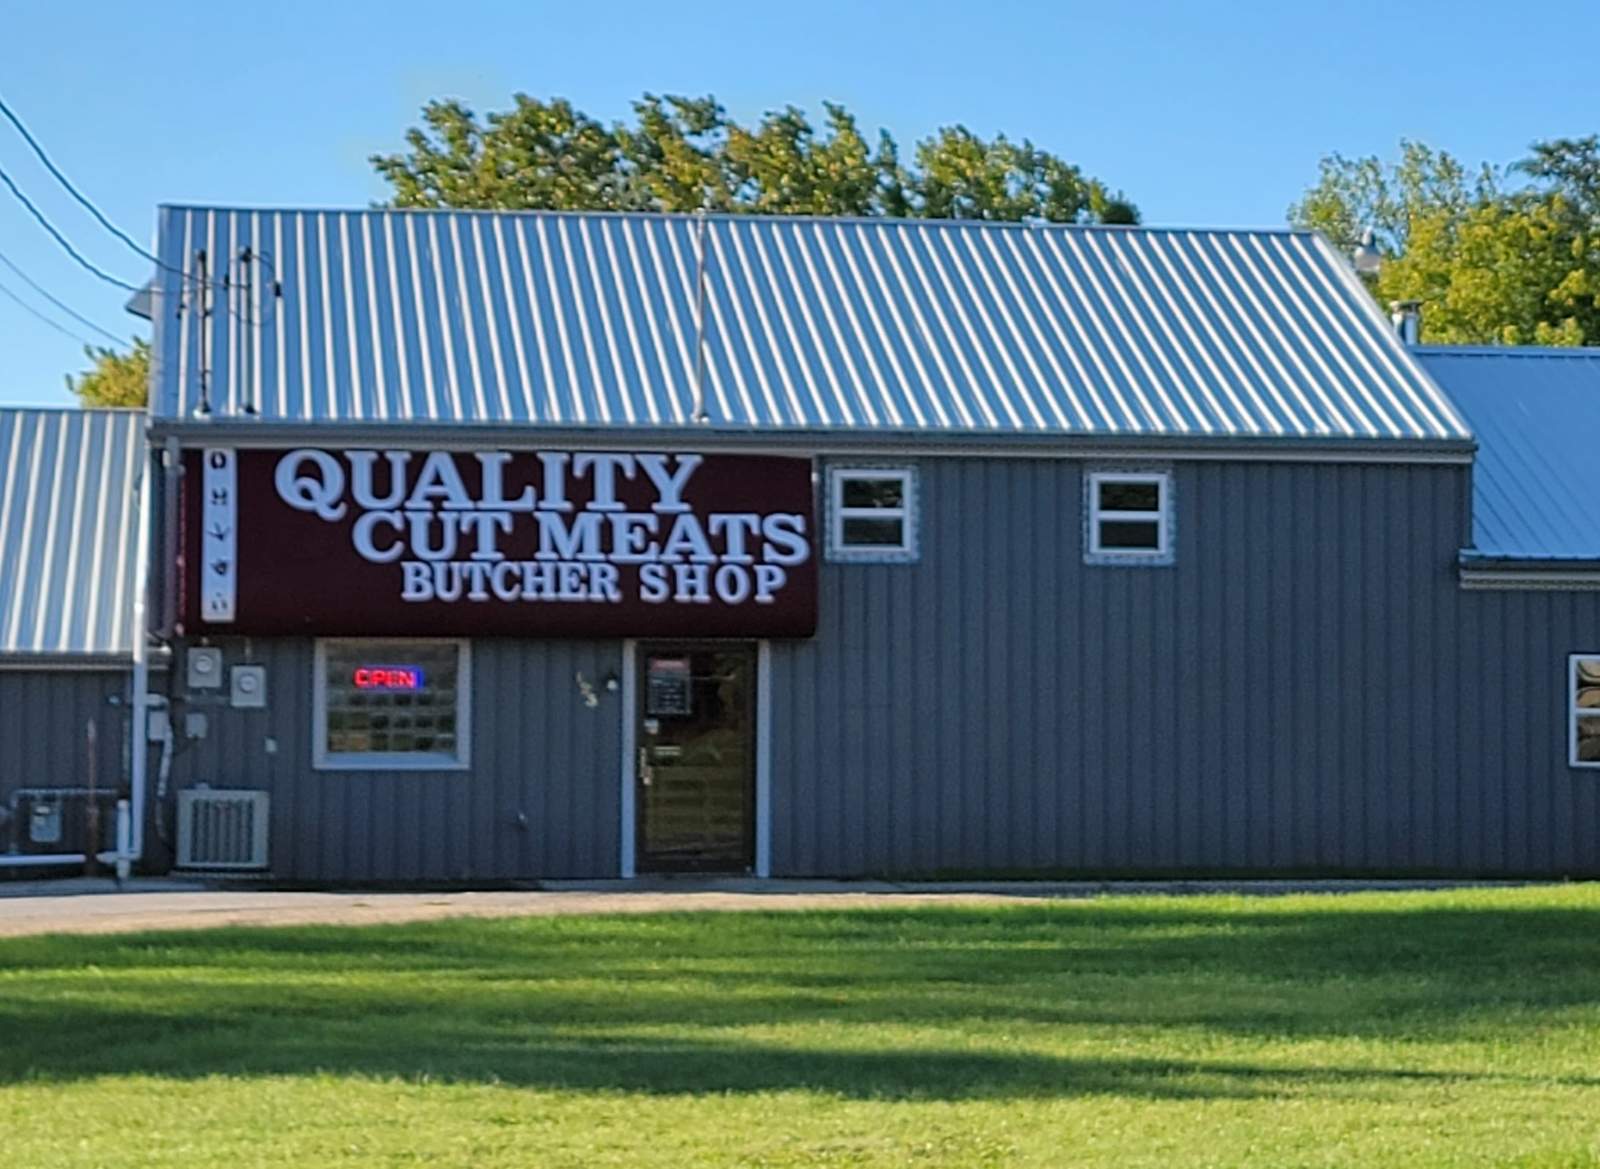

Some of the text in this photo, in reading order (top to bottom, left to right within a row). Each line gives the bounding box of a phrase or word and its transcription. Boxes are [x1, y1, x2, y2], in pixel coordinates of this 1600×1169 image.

[275, 450, 703, 520] QUALITY
[353, 511, 810, 565] CUT MEATS
[402, 562, 787, 603] BUTCHER SHOP
[354, 669, 417, 688] OPEN
